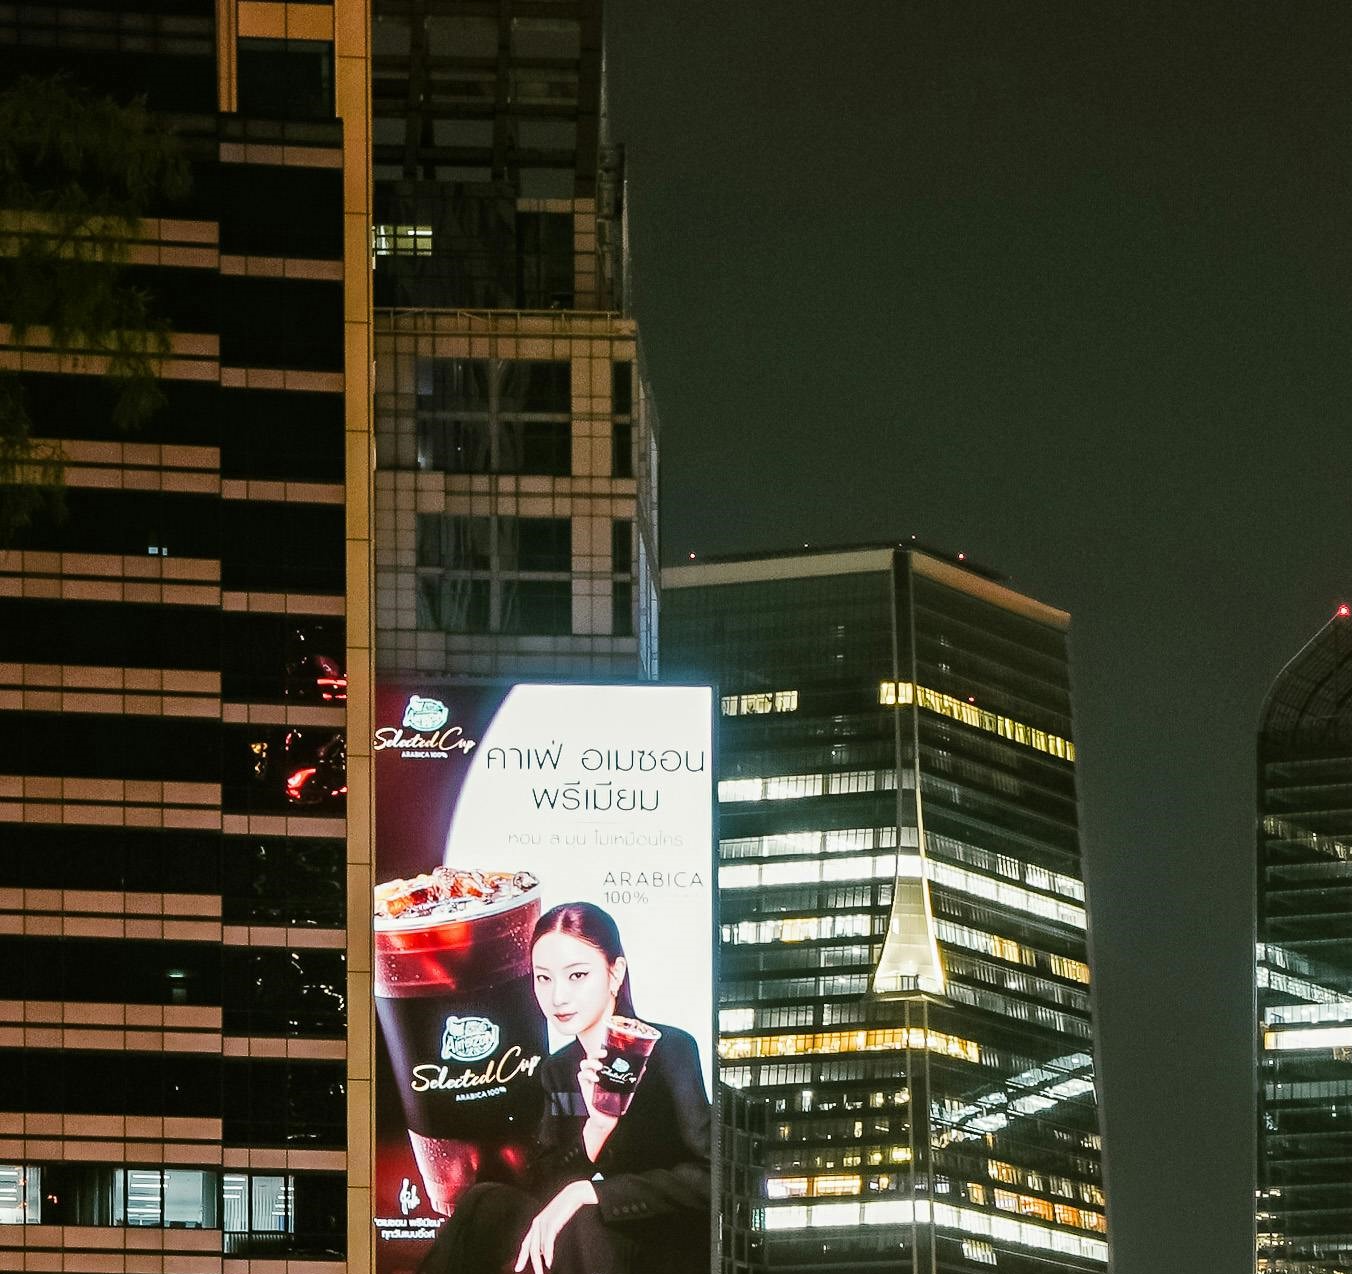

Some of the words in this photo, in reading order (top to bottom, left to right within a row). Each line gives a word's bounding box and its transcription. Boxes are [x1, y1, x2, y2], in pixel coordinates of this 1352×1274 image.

[439, 726, 476, 754] Cup
[487, 740, 563, 770] คาเฟ่
[581, 748, 704, 772] อเมซอน
[532, 780, 659, 811] พรีเมียม
[603, 871, 704, 888] ARABICA
[605, 890, 649, 904] 100%
[410, 1060, 496, 1092] Selected
[496, 1045, 541, 1083] Cup
